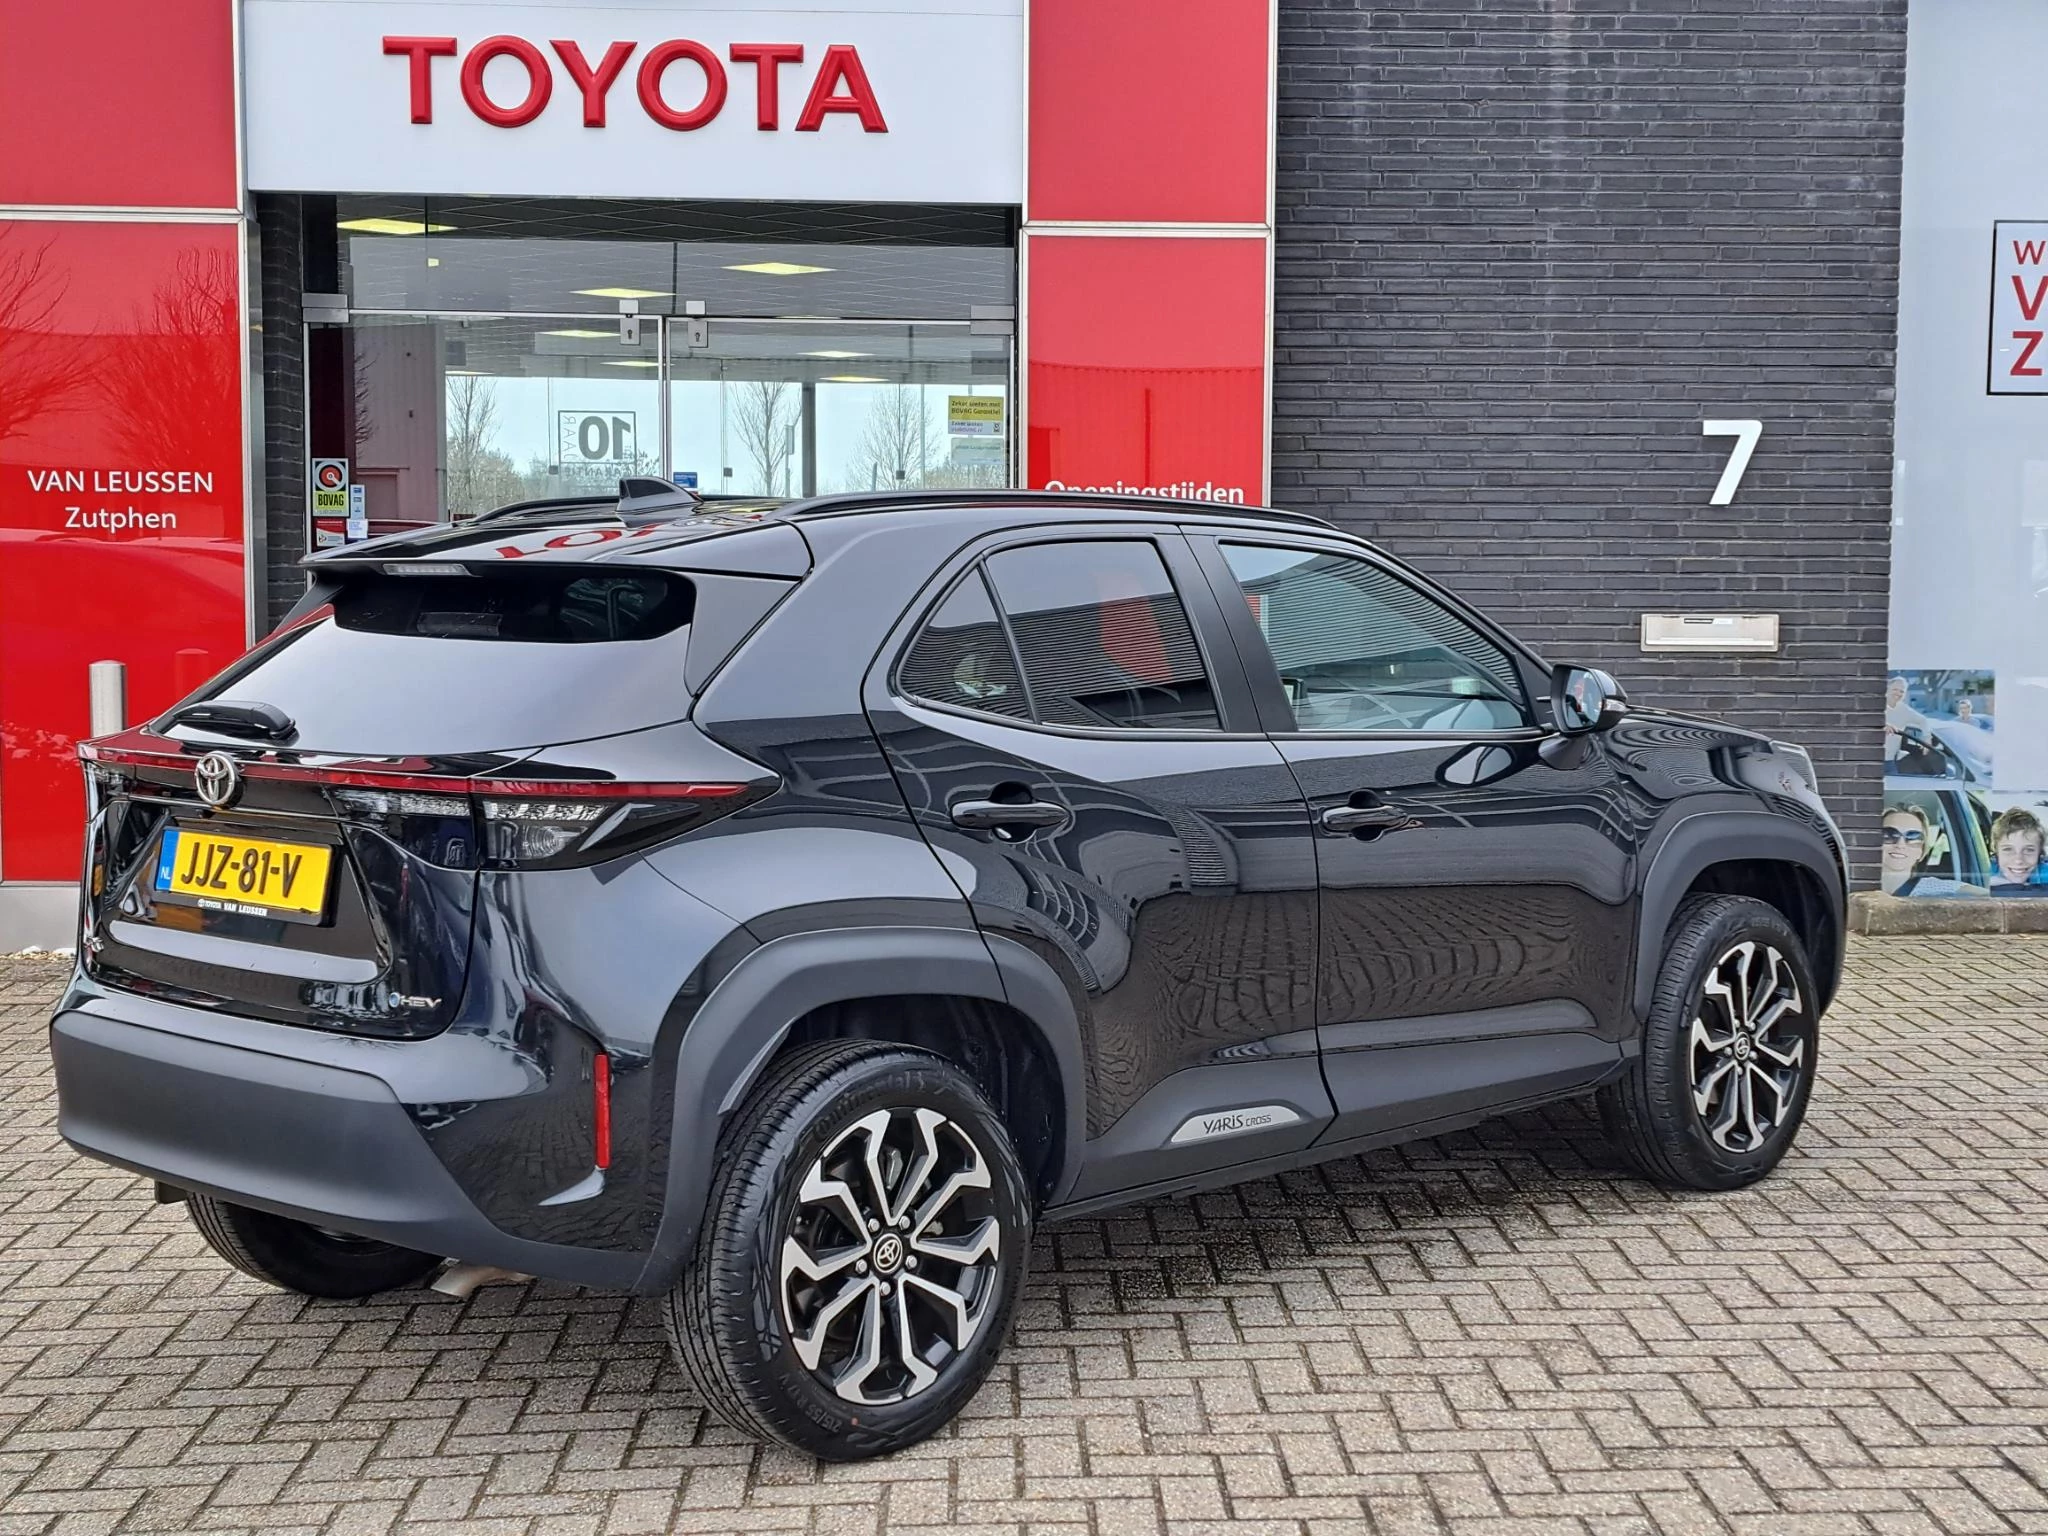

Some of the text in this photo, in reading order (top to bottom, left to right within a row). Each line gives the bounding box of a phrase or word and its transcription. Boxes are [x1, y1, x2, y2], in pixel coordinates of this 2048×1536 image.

[382, 34, 889, 133] TOYOTA
[1702, 419, 1764, 506] 7
[27, 470, 213, 493] VAN LEUSSEN
[318, 494, 344, 506] BOVAG
[64, 506, 177, 534] Zutphen
[160, 866, 171, 880] NL
[180, 841, 303, 898] JJZ-81-V
[223, 902, 236, 912] VAN
[1245, 1114, 1272, 1127] CROSS
